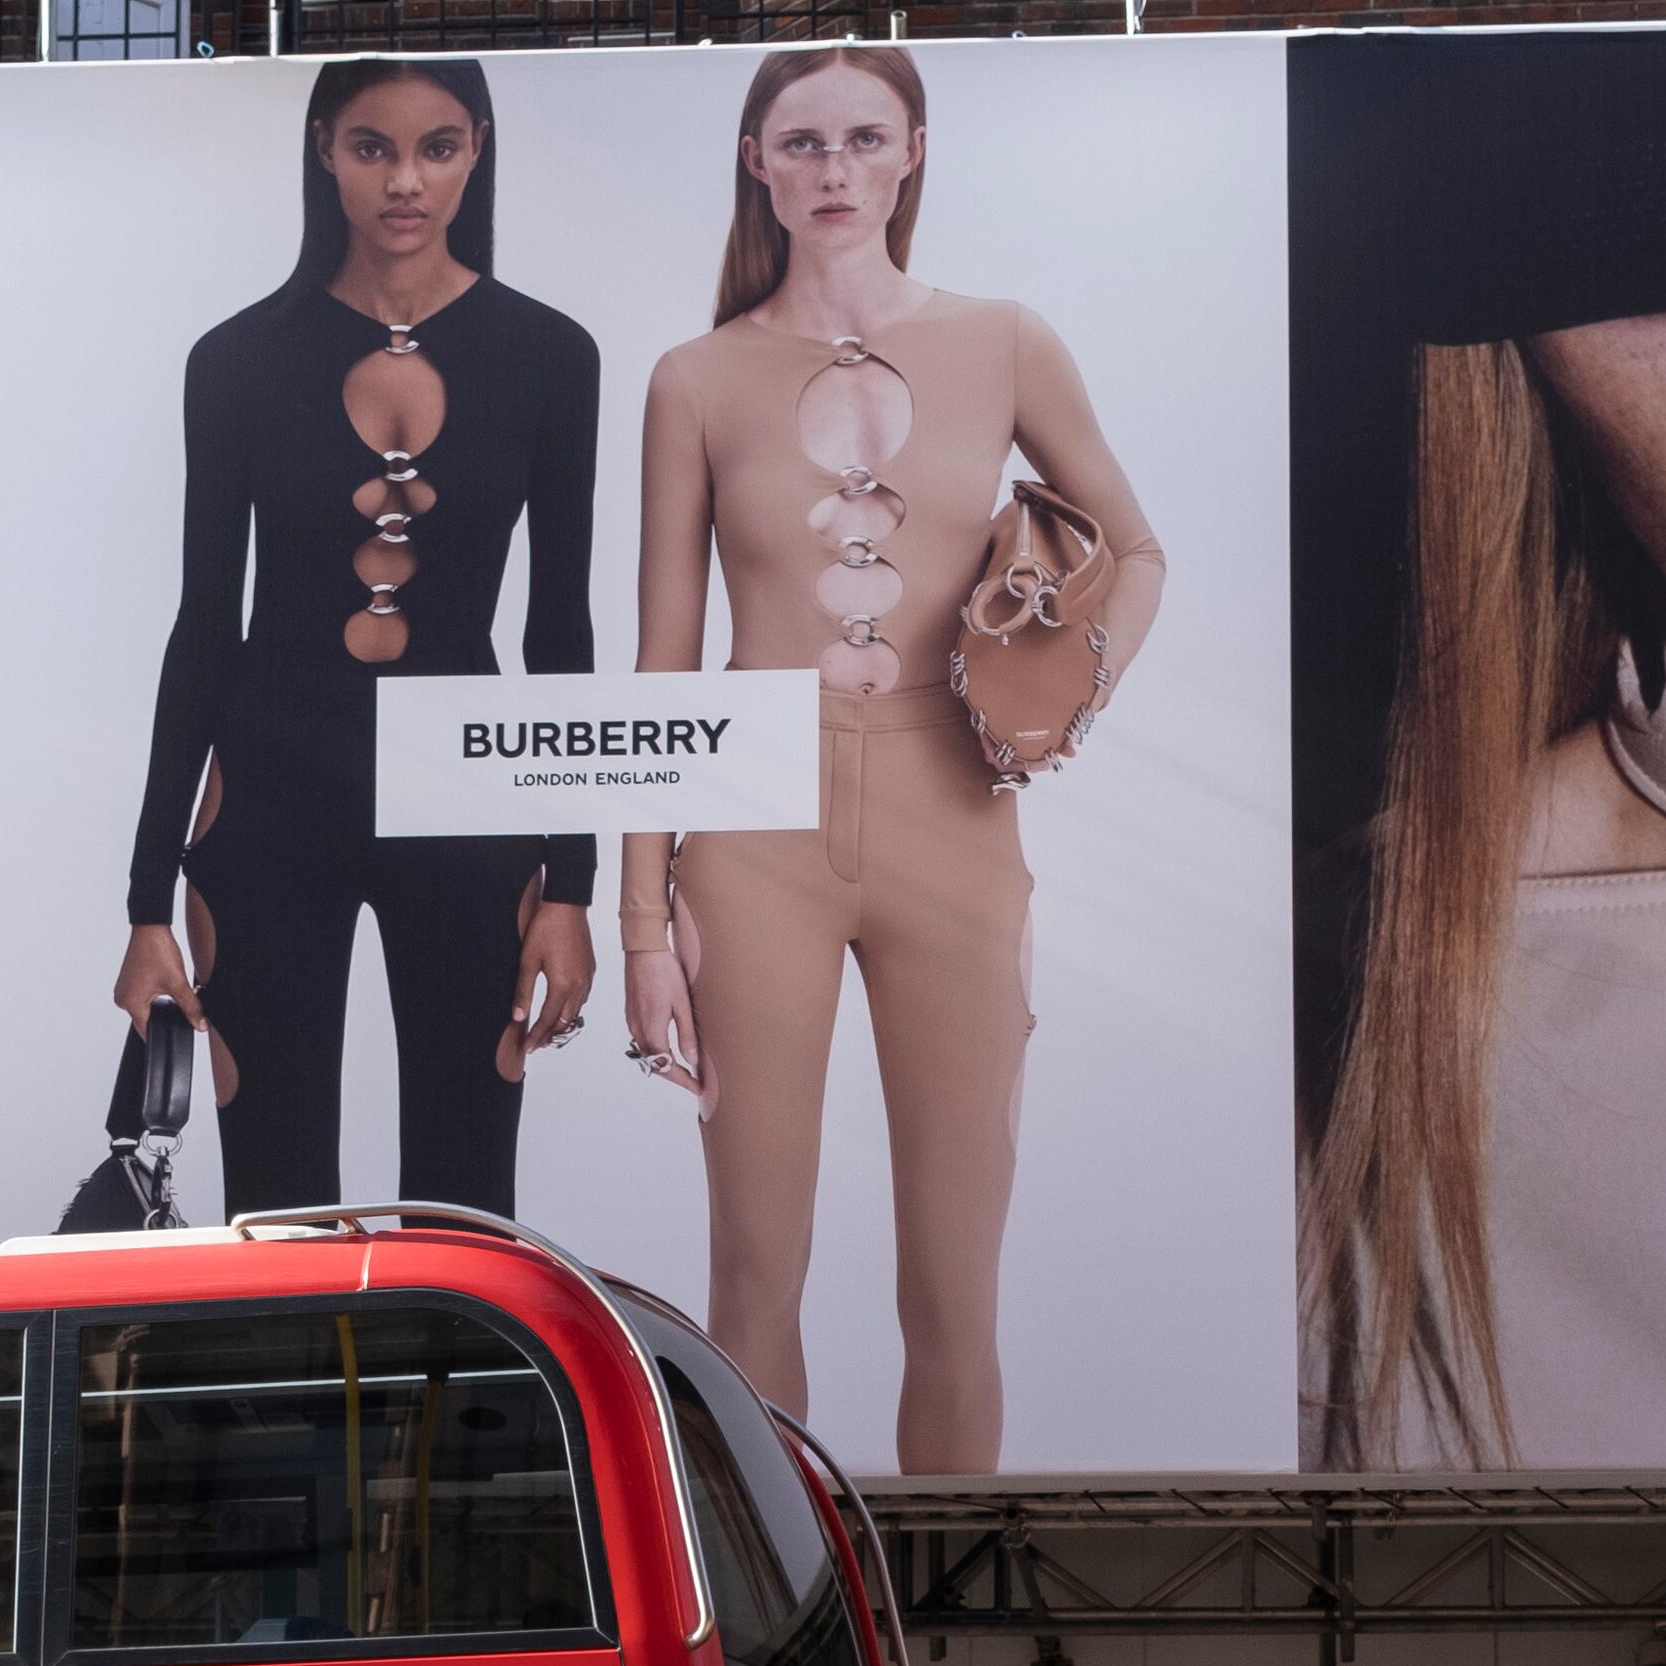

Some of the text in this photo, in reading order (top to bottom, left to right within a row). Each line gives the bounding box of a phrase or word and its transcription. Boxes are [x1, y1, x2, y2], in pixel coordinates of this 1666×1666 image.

[463, 718, 731, 759] BURBERRY
[514, 771, 680, 787] LONDON ENGLAND
